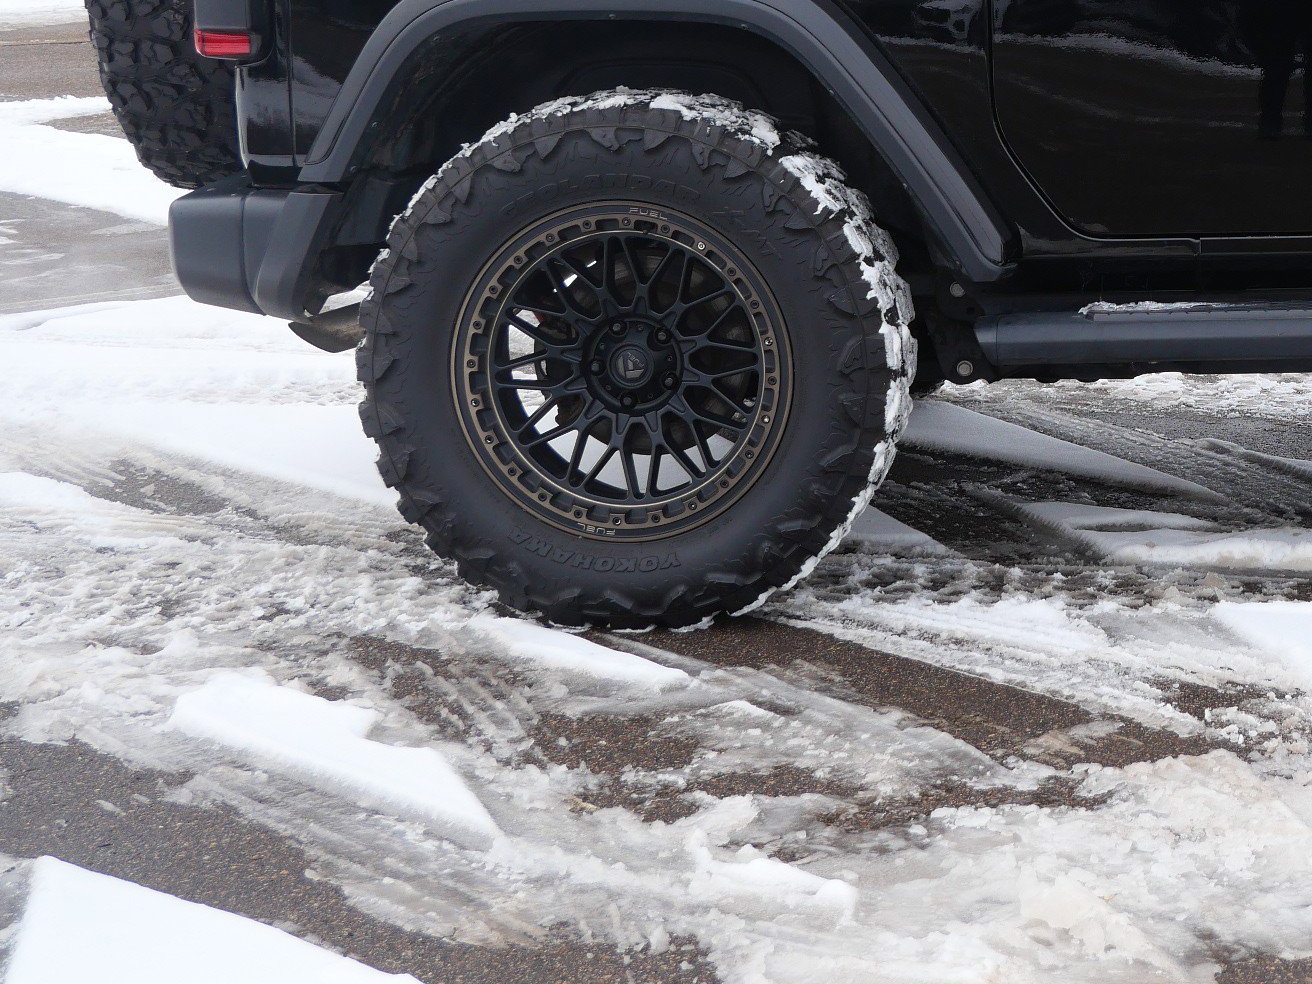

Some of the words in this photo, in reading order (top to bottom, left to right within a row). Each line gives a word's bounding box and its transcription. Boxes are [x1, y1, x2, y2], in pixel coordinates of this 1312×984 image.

[628, 207, 669, 221] FUEL
[577, 522, 616, 536] FUEL
[507, 525, 682, 573] YOKOHAMA
